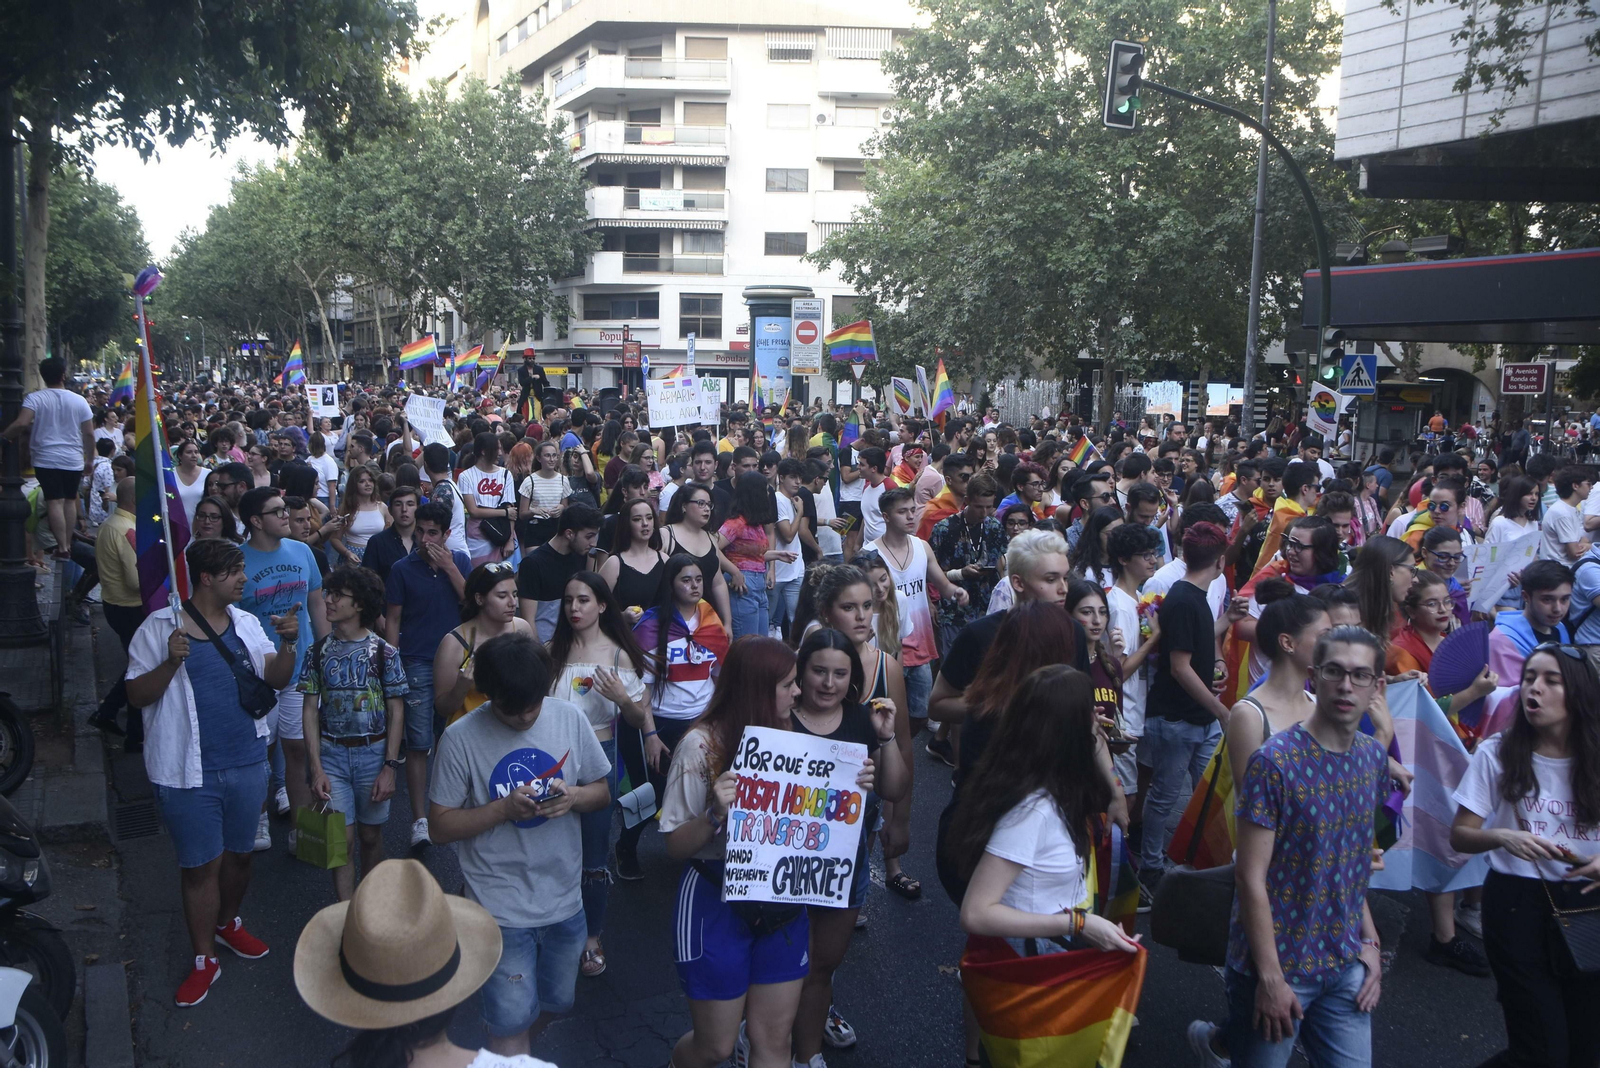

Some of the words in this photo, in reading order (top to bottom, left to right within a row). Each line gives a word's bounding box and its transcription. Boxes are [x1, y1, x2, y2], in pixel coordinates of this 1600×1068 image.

[599, 331, 634, 343] Popur
[715, 354, 746, 363] Popular
[252, 566, 275, 584] WEST
[275, 564, 303, 575] COAST
[261, 606, 304, 617] CALIFOA
[1093, 687, 1117, 705] NGE
[773, 752, 808, 775] QUÉ
[807, 759, 836, 778] SER
[780, 780, 862, 825] HOMÓFOBO
[771, 855, 853, 901] CALLARTE?
